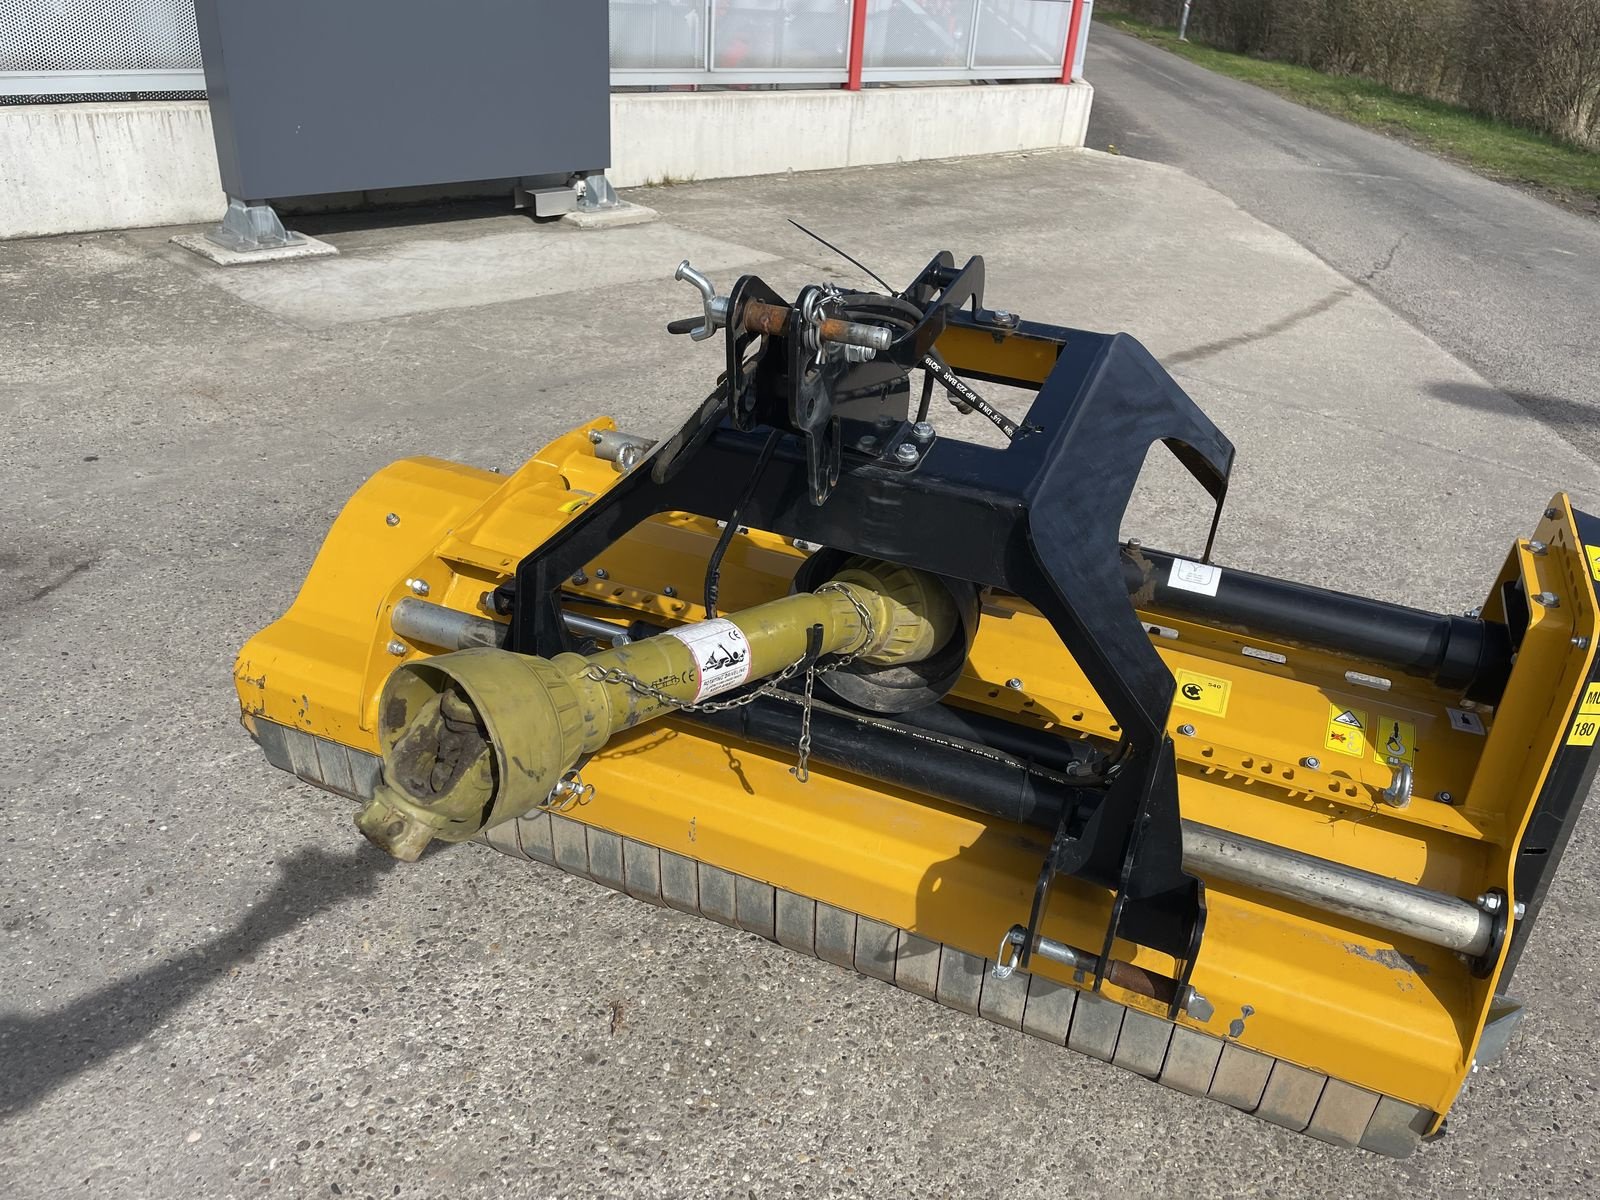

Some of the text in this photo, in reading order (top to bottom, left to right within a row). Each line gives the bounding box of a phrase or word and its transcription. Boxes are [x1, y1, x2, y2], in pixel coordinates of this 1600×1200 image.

[925, 357, 941, 372] 3Q19
[943, 372, 957, 386] BAR
[956, 382, 967, 395] 225
[965, 391, 977, 402] WP
[982, 405, 993, 417] DN
[1208, 682, 1221, 690] 540
[1574, 722, 1596, 737] 180
